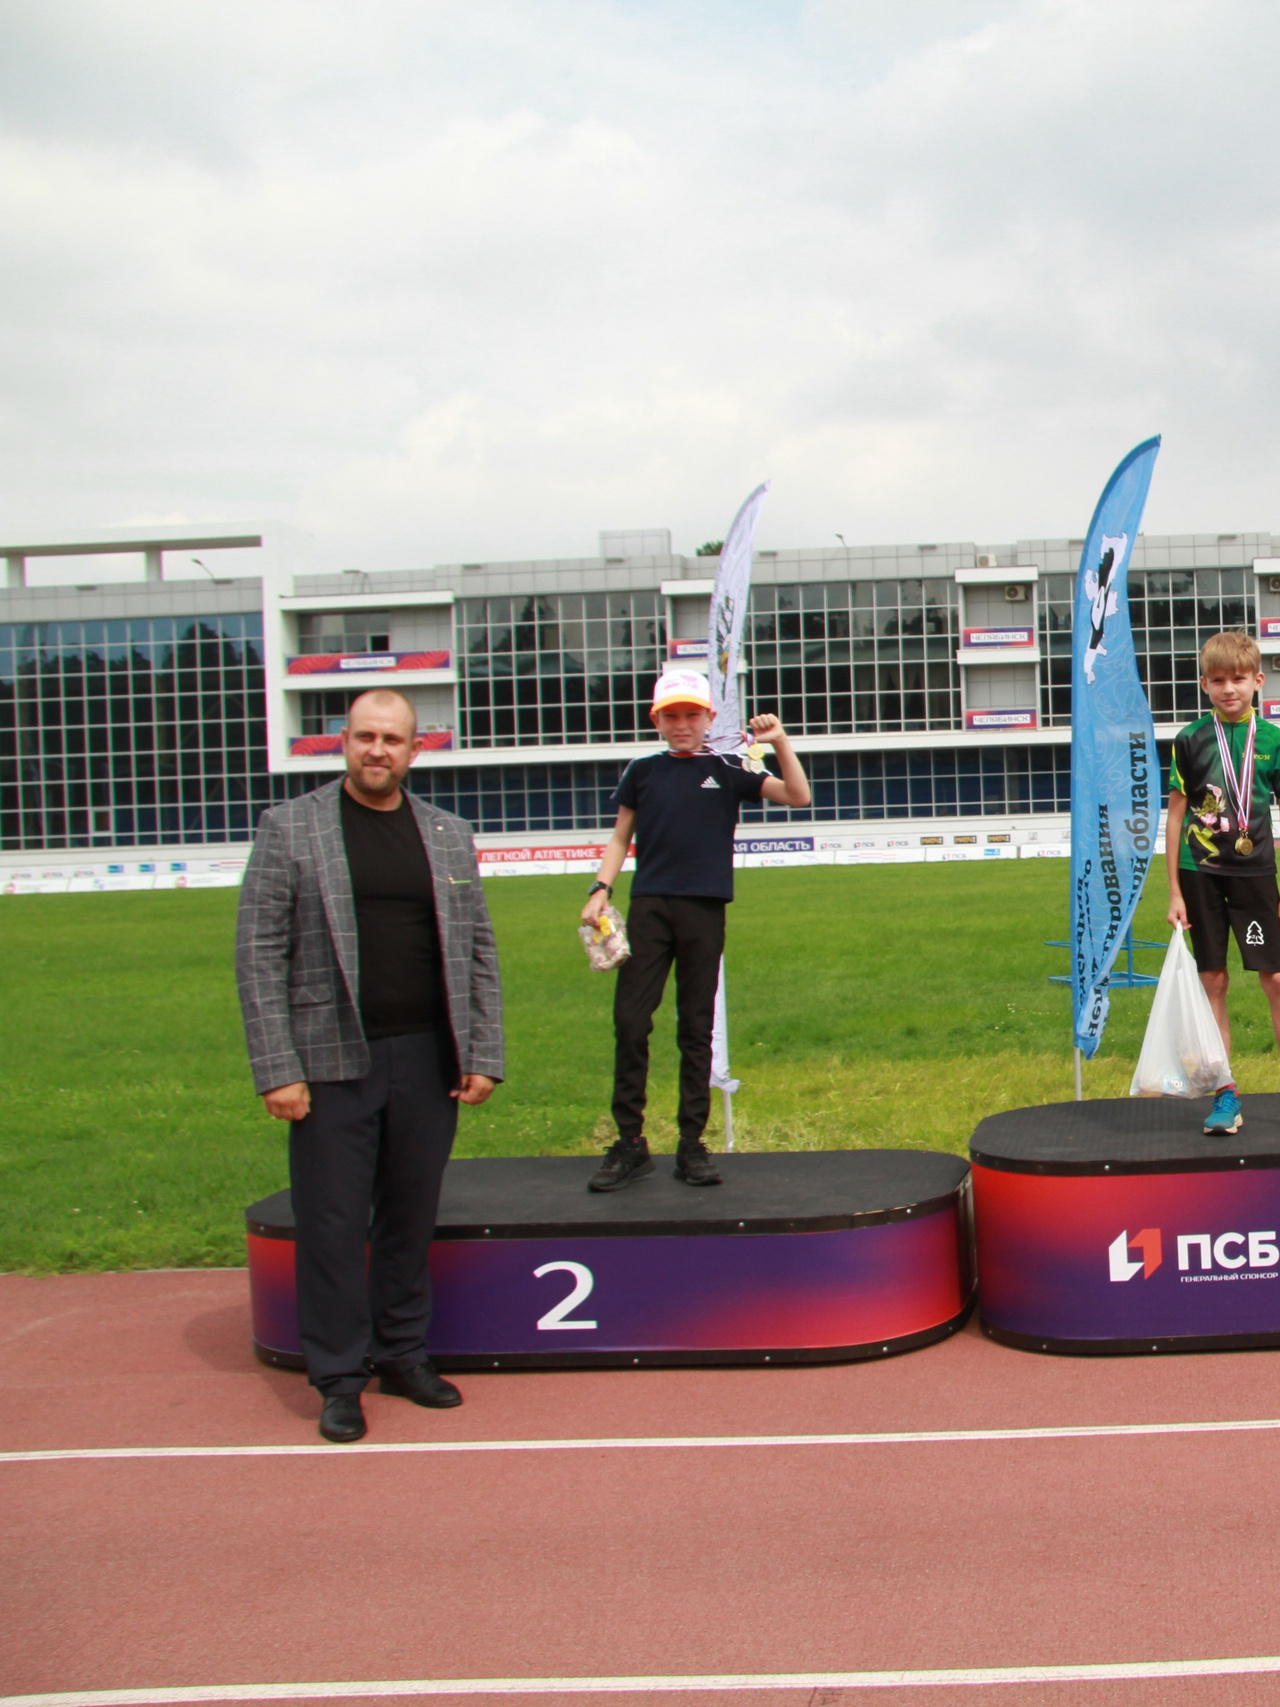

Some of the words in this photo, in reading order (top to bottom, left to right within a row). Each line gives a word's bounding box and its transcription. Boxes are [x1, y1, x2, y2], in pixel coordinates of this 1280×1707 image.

[971, 632, 1027, 642] ЧЕЛЯБИНСК
[974, 714, 1029, 724] ЧЕЛЯБИНСК
[1123, 730, 1149, 852] области
[749, 840, 812, 851] ОБЛАСТЬ
[481, 848, 531, 862] ЛЕГКОЙ
[533, 847, 596, 860] АТЛЕТИКЕ
[1176, 1230, 1280, 1271] ПСБ
[1180, 1273, 1239, 1283] ГЕНЕРАЛЬНЫЙ
[1239, 1271, 1279, 1281] СПОНСОР
[532, 1260, 598, 1331] 2
